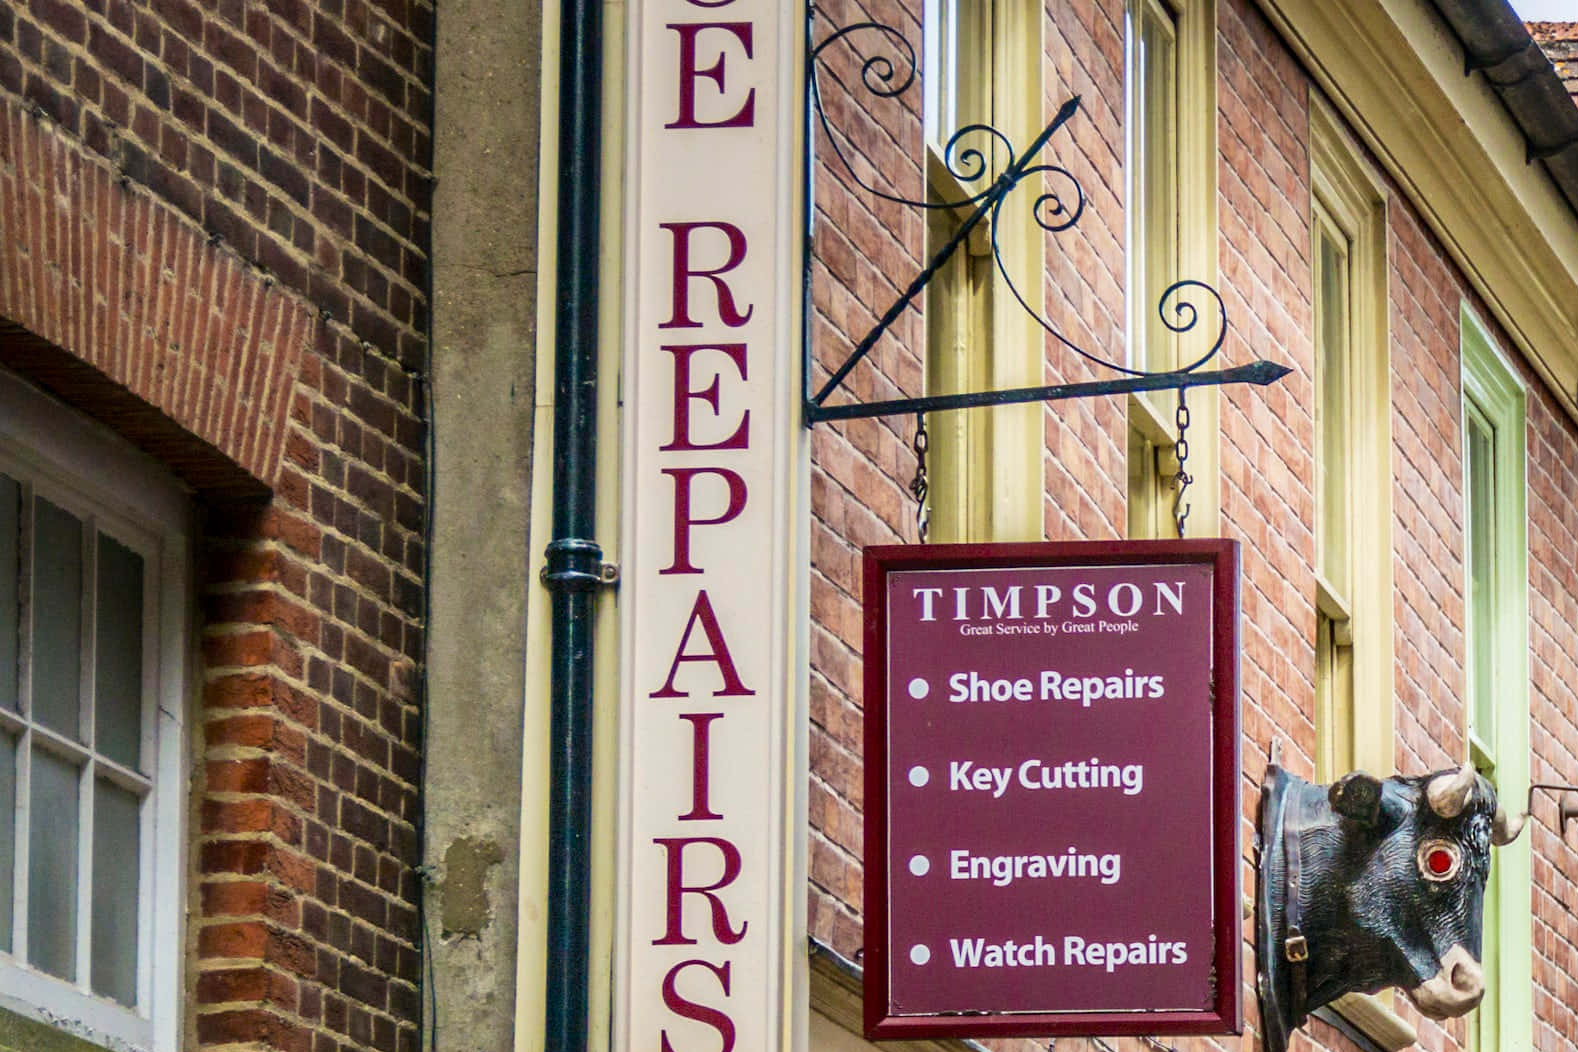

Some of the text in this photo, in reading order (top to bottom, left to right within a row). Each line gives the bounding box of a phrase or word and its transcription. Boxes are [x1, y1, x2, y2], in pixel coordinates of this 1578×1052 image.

[664, 0, 757, 131] E
[912, 581, 1186, 622] TIMPSON
[960, 619, 1139, 636] Great Service by Great People
[949, 668, 1164, 706] Shoe Repairs
[949, 758, 1144, 797] Key Cutting
[949, 847, 1121, 886] Engraving
[949, 934, 1188, 972] Watch Repairs
